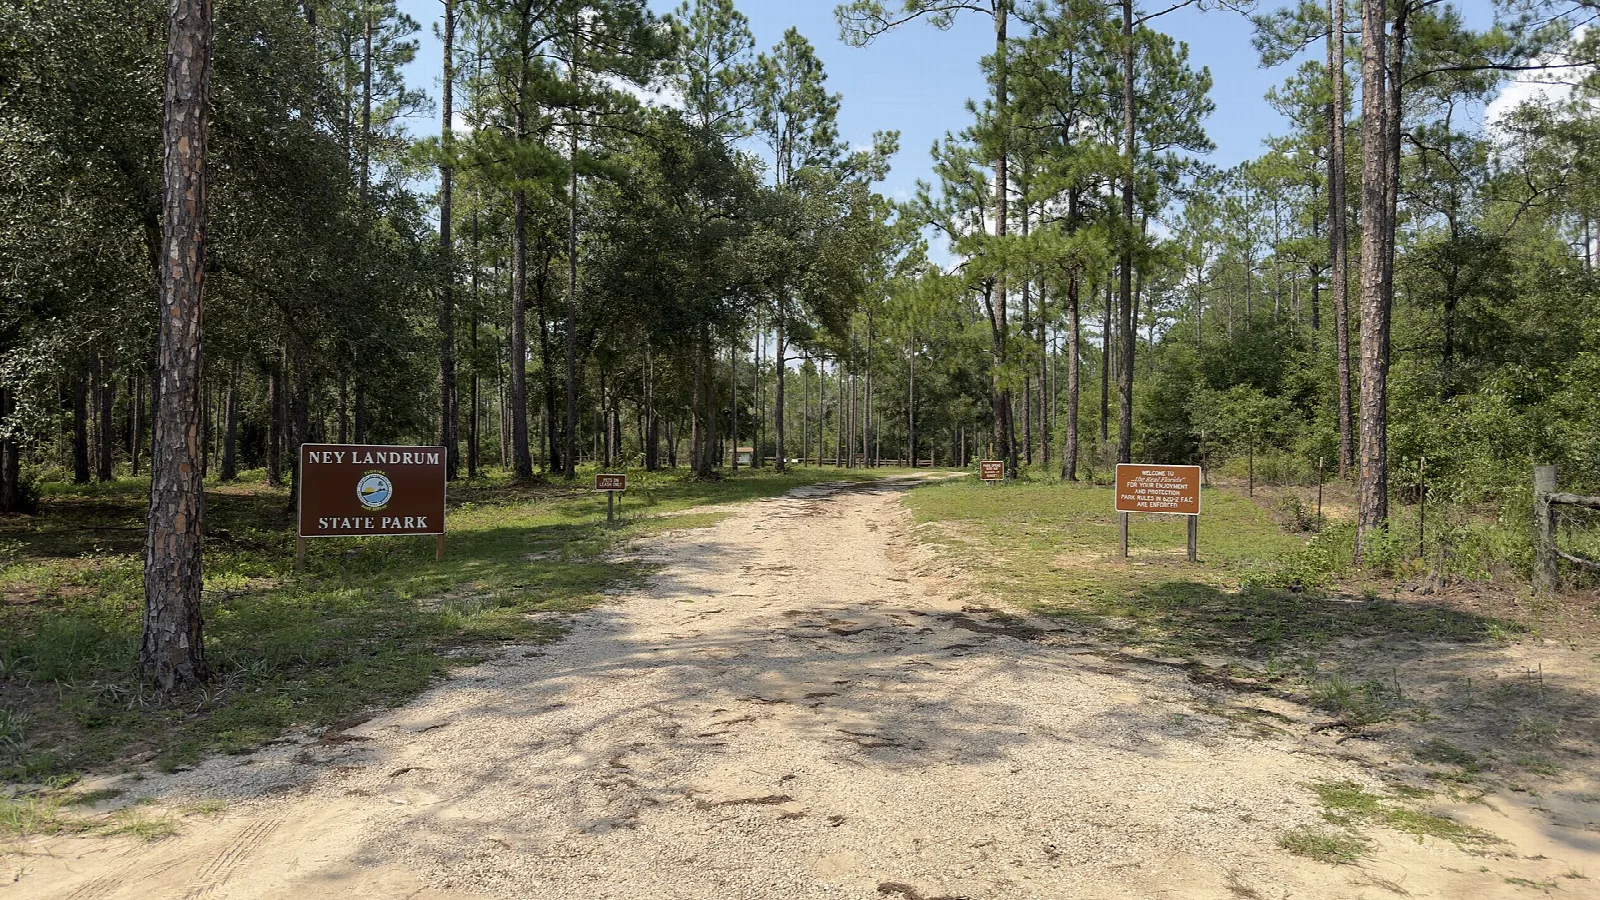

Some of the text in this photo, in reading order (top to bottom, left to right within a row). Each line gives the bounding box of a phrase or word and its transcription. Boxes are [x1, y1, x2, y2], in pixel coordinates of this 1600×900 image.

[309, 452, 440, 464] NEY LANDRUM
[318, 516, 427, 529] STATE PARK
